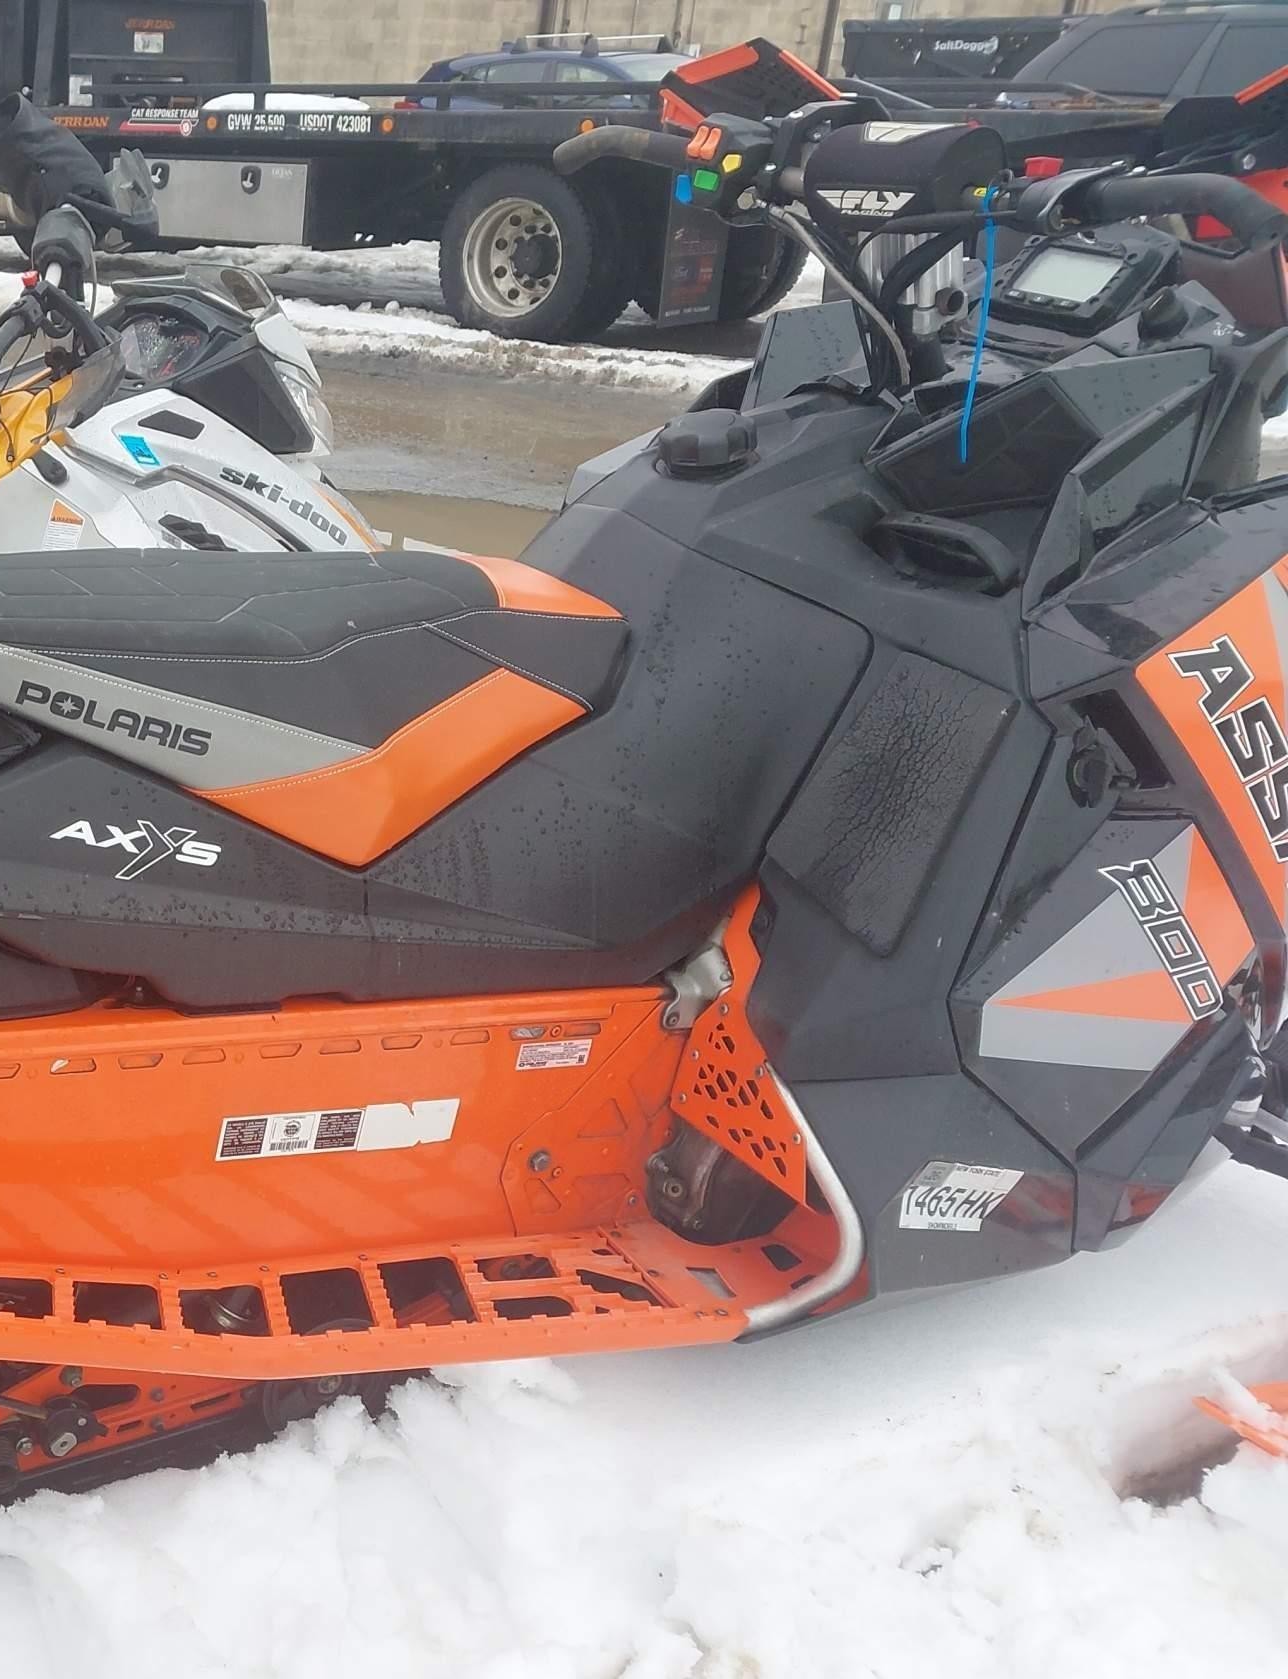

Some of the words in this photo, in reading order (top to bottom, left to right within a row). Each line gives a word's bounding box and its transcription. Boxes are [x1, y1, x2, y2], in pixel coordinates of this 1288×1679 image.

[132, 108, 145, 118] CAT
[145, 109, 179, 118] RESPONSE
[179, 109, 199, 118] TEAM
[227, 113, 252, 131] GVW
[299, 114, 334, 132] USDOT
[336, 115, 371, 133] 423081
[816, 190, 916, 211] FLY
[841, 209, 894, 217] RACING
[220, 467, 348, 546] ski-doo
[15, 680, 212, 756] POLARIS
[1168, 634, 1288, 864] ASS
[1098, 859, 1223, 1021] 800
